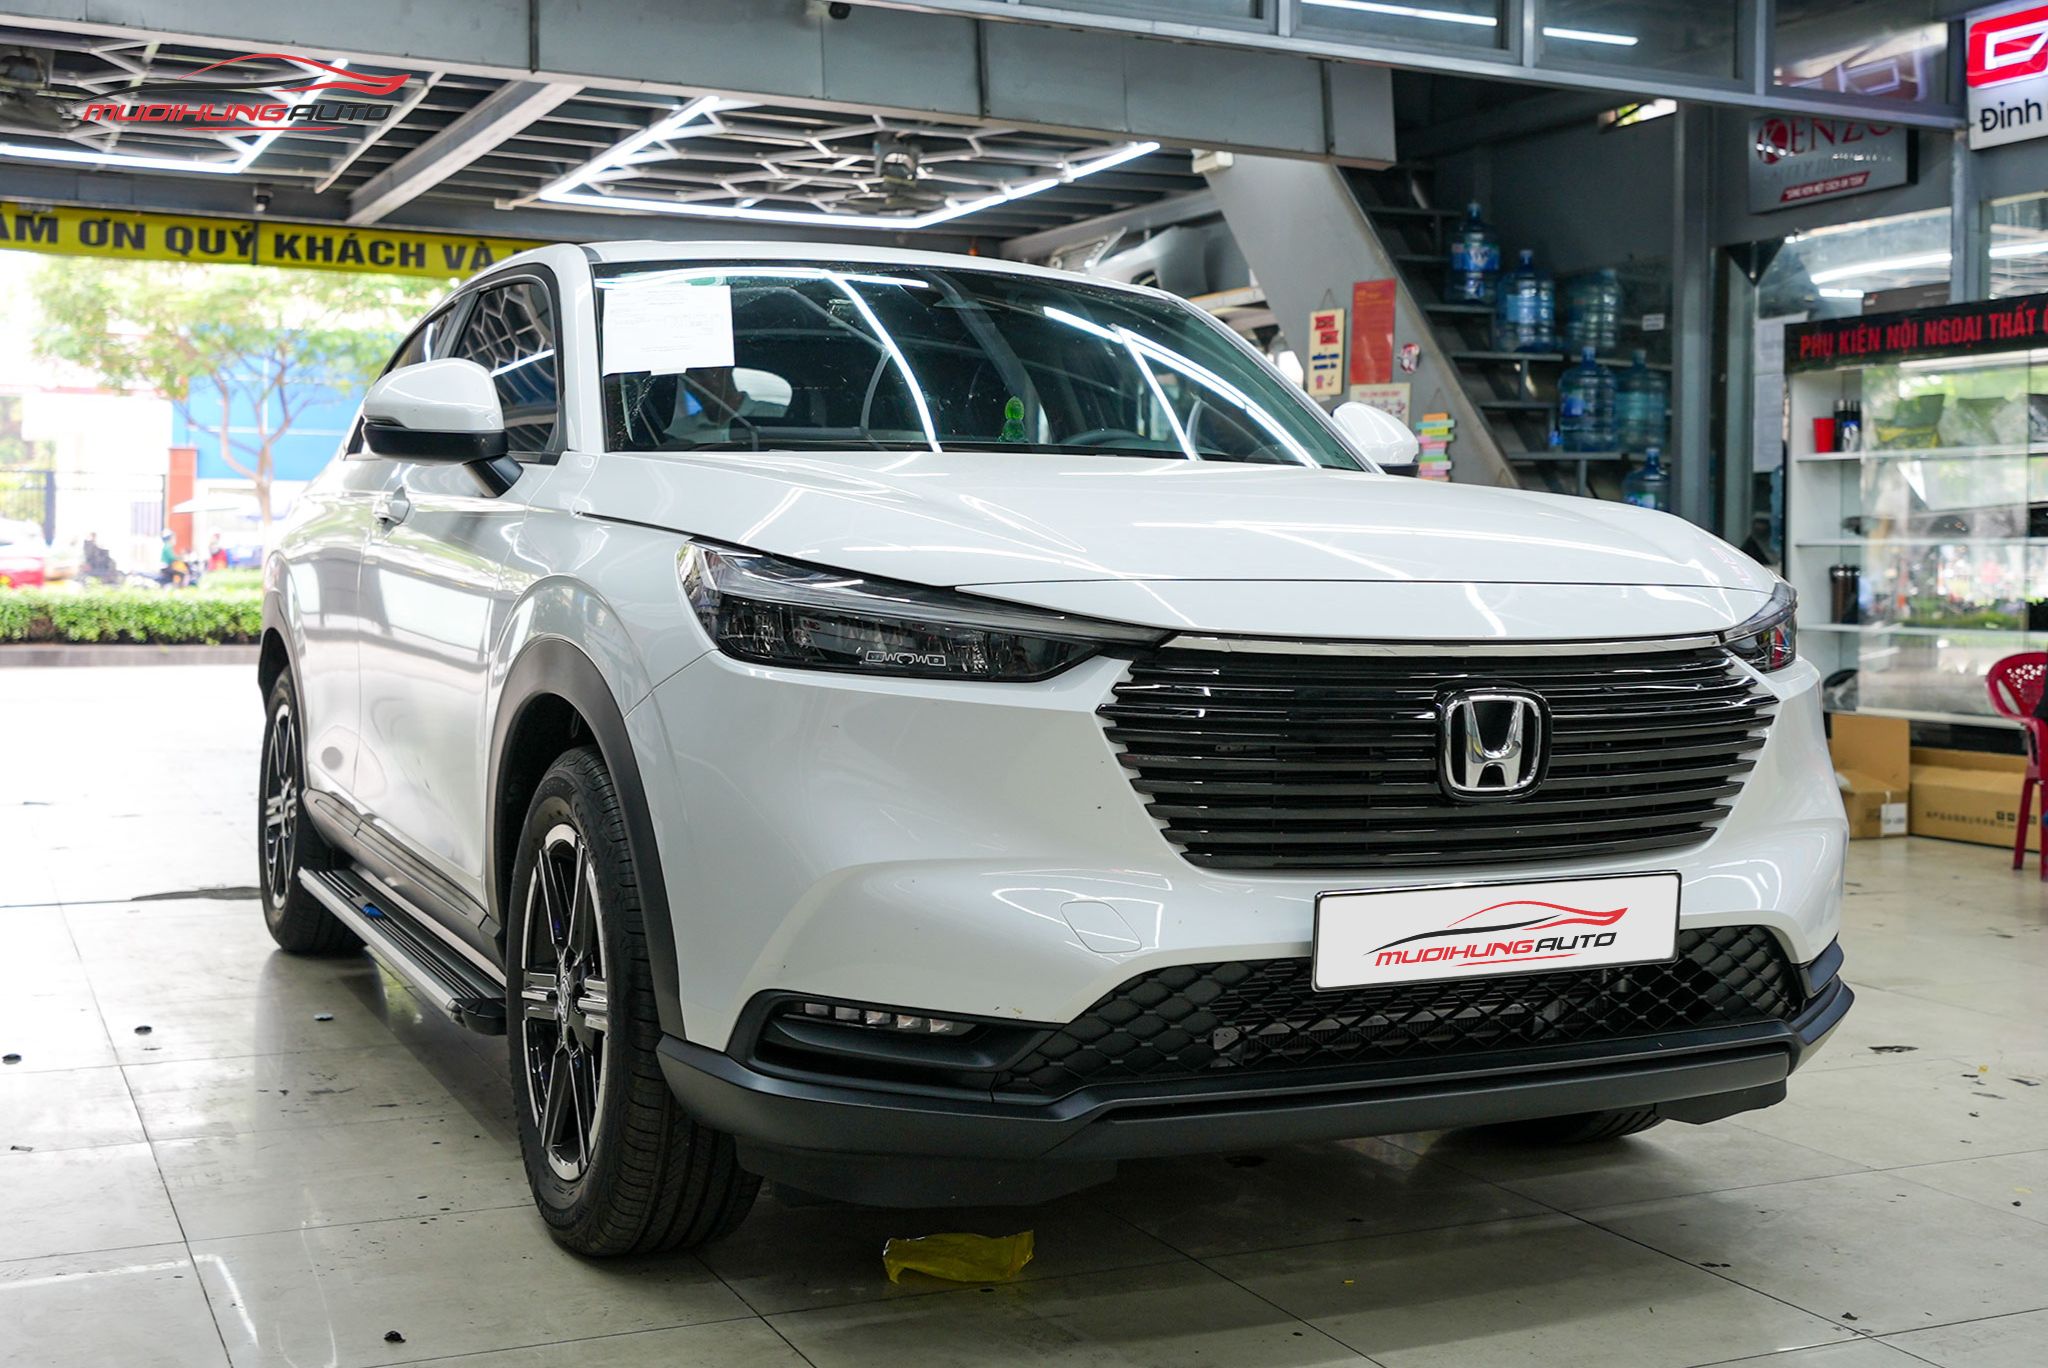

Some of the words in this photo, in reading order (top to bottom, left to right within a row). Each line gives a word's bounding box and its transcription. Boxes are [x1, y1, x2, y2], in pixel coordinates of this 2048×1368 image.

[79, 218, 146, 250] ƠN
[165, 225, 256, 257] QUÝ
[274, 232, 425, 269] KHÁCH
[441, 240, 494, 271] VÀ
[1800, 331, 1833, 363] PHỤ
[1839, 323, 1881, 358] KIỆN
[1886, 317, 1918, 353] NỘI
[1924, 314, 1983, 348] NGOẠI
[1989, 301, 2037, 340] THẤT
